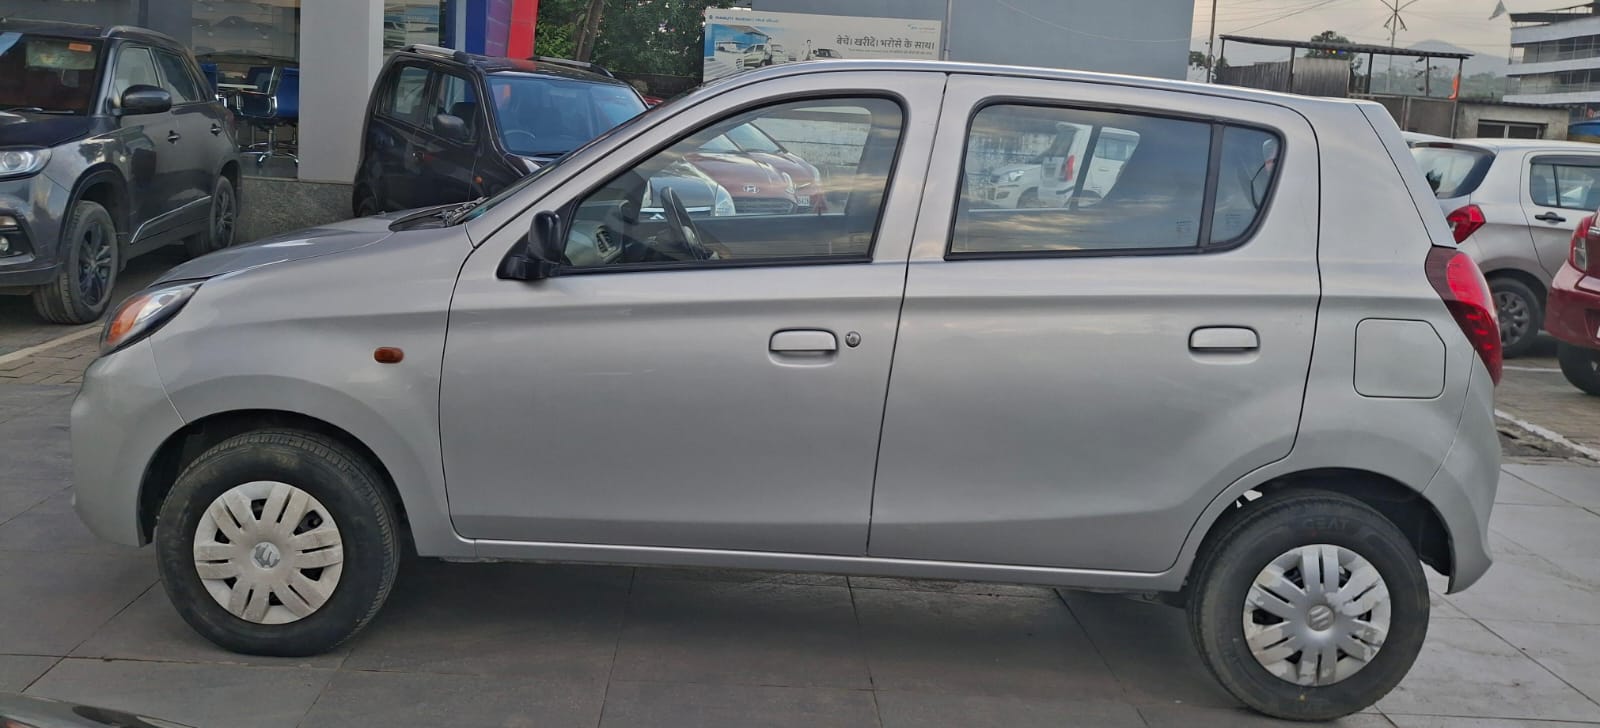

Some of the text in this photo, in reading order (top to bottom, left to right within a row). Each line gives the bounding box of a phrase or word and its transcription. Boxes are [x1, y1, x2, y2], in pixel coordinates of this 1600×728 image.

[880, 37, 902, 48] भरोसे
[904, 38, 913, 49] के
[1303, 518, 1350, 530] CEAT
